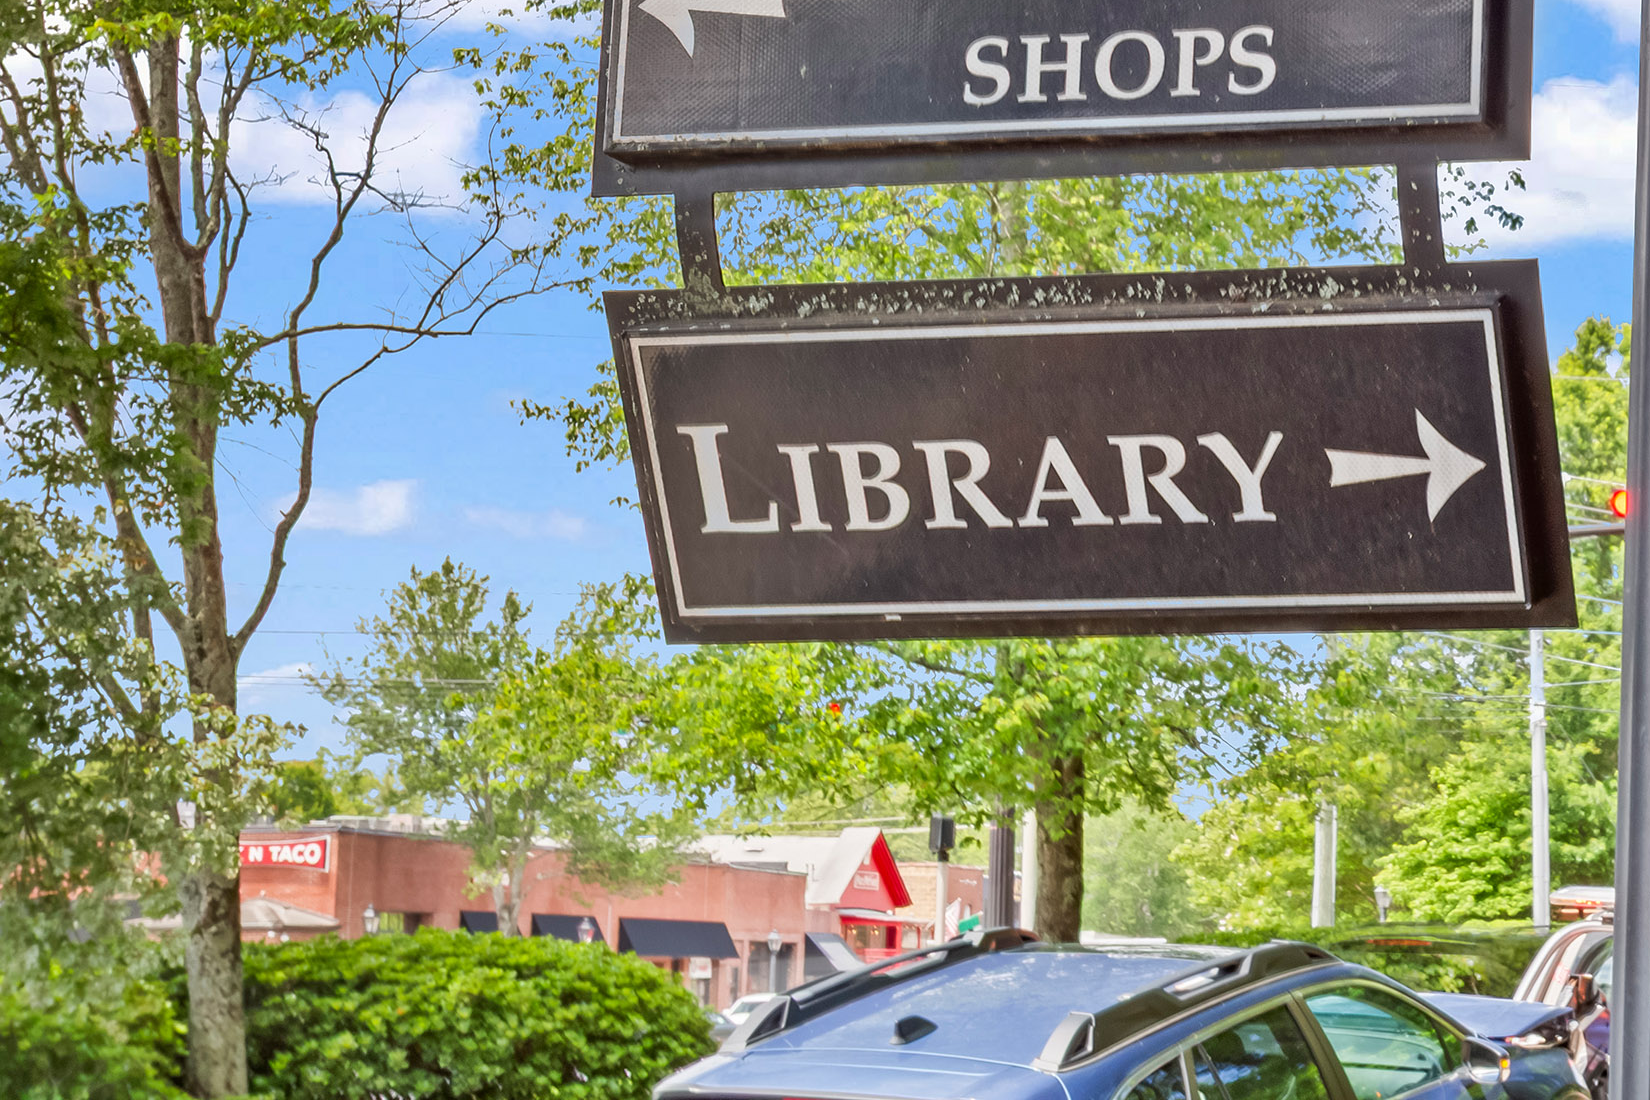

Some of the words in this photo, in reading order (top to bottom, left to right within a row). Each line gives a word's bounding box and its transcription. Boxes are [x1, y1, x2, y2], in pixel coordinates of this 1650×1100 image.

[963, 25, 1277, 106] SHOPS
[676, 424, 1283, 533] LIBRARY
[249, 846, 264, 862] N
[269, 843, 322, 865] TACO
